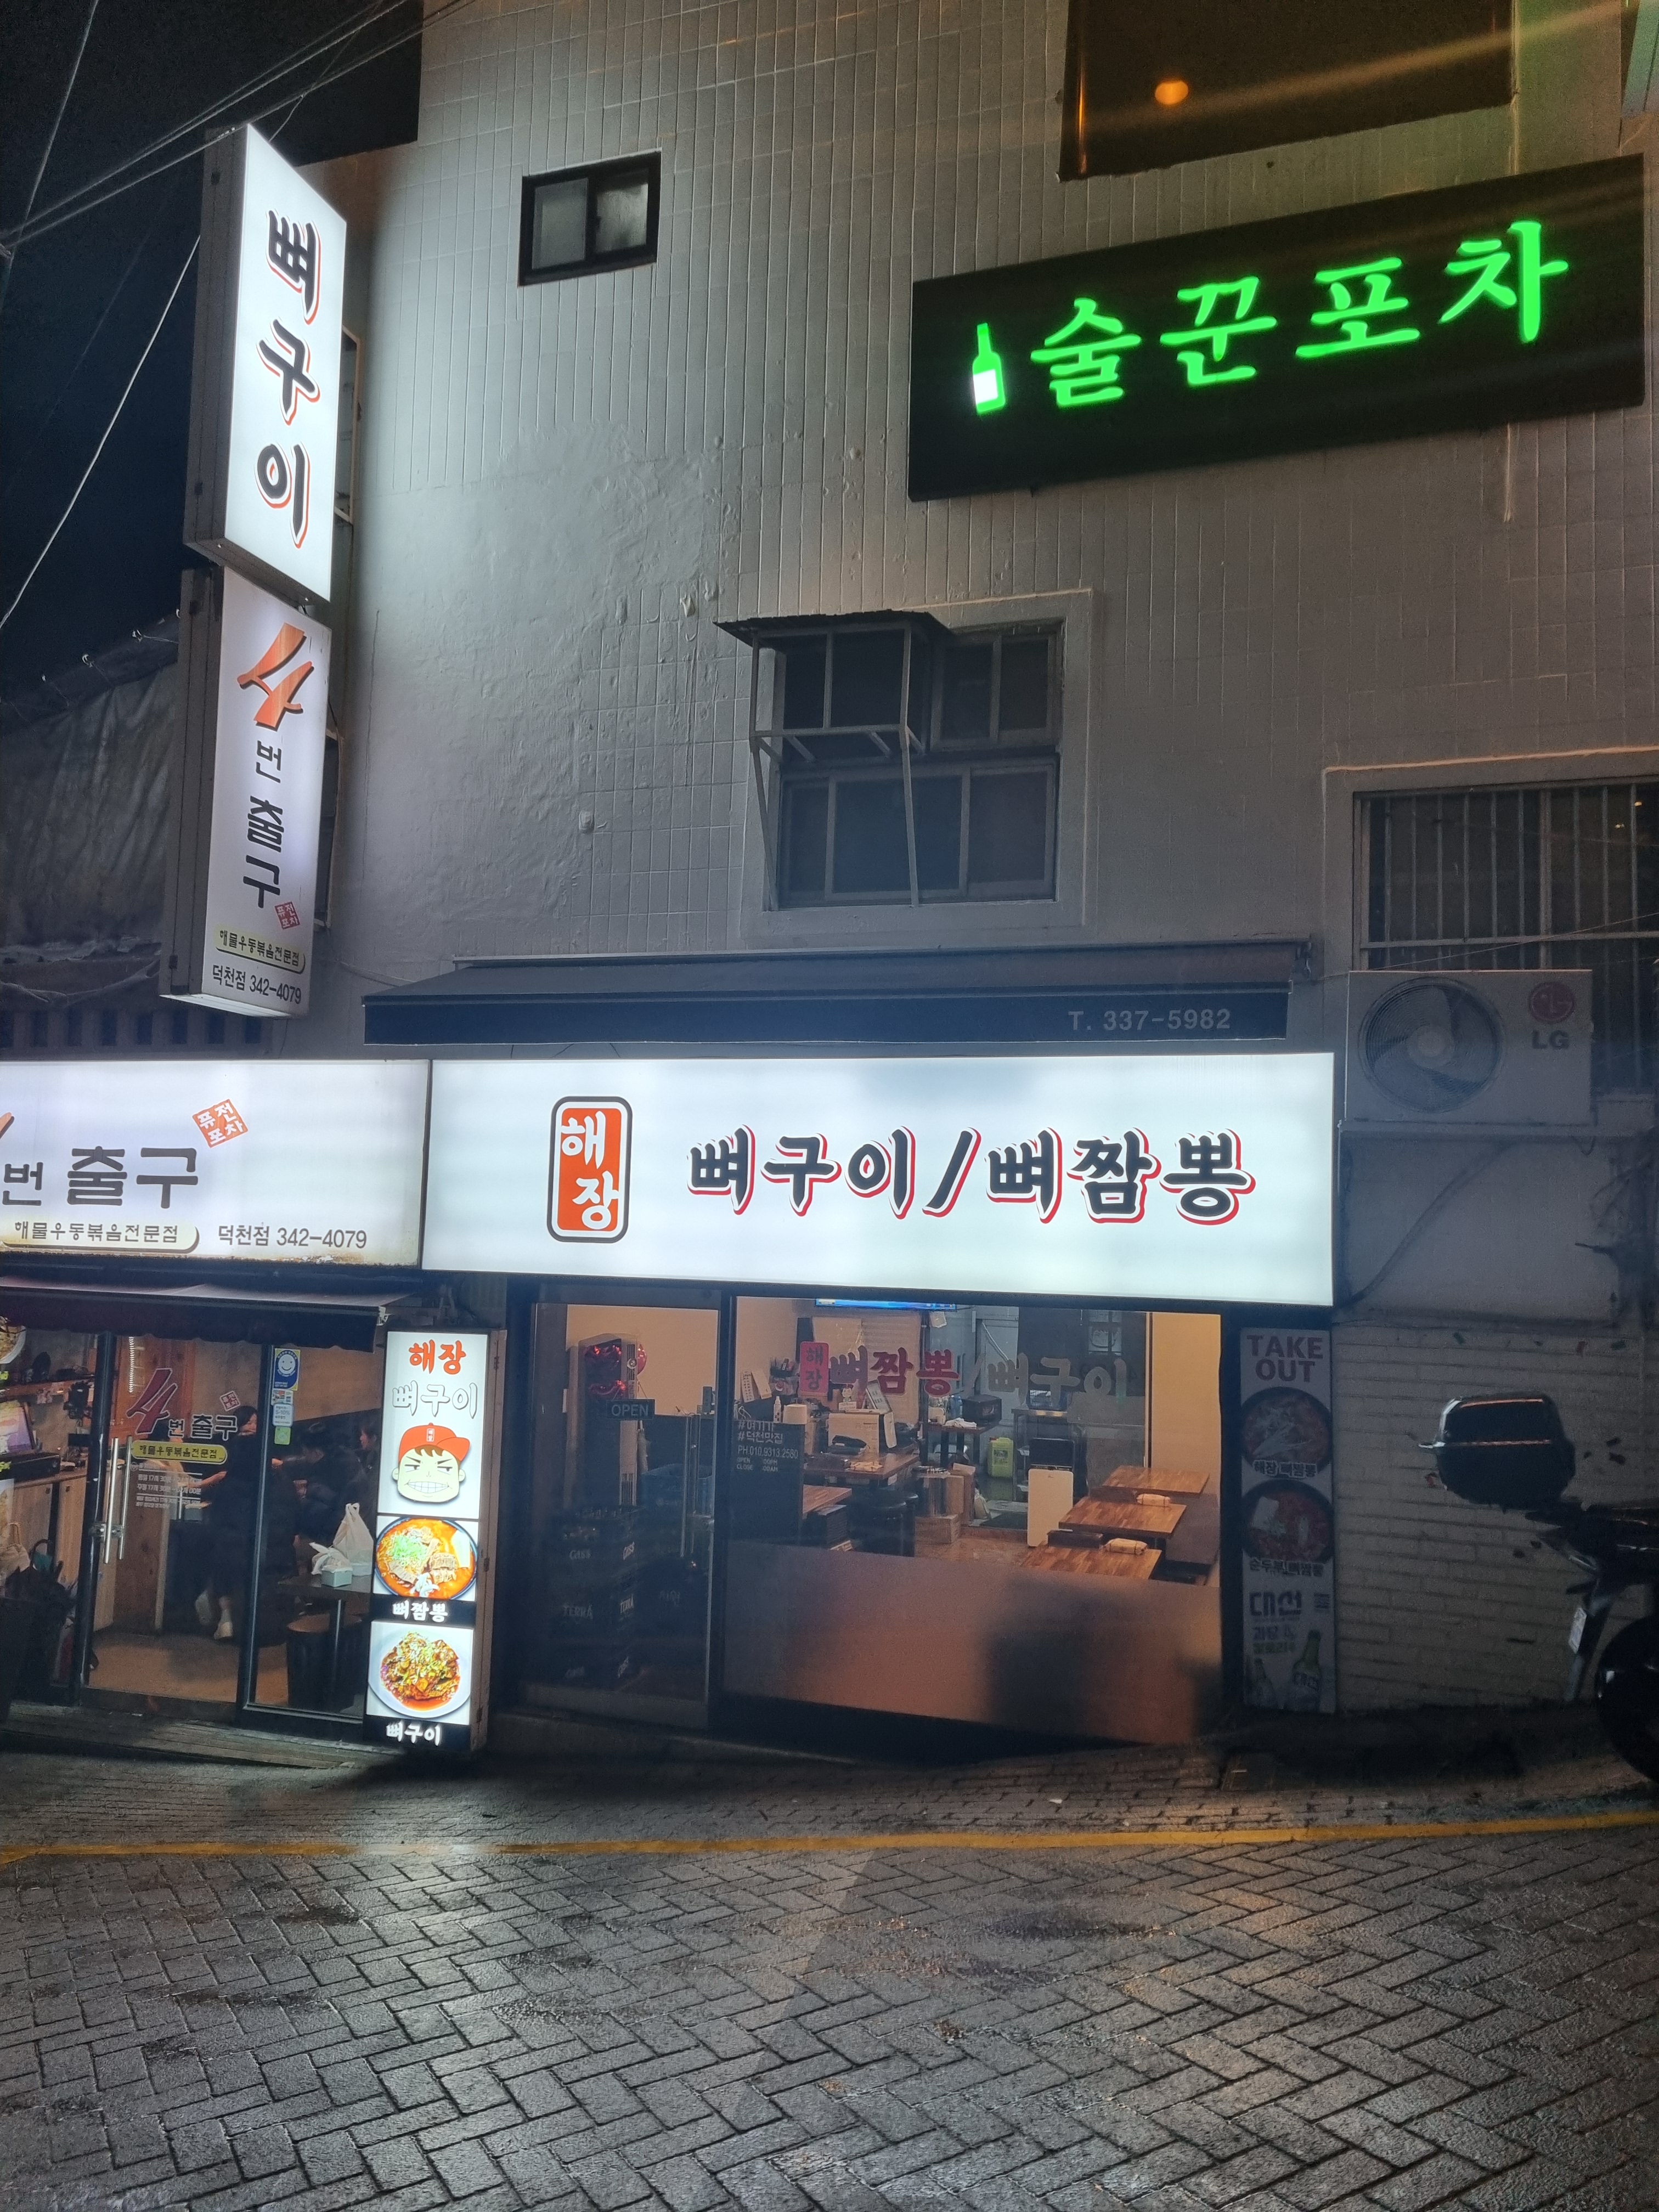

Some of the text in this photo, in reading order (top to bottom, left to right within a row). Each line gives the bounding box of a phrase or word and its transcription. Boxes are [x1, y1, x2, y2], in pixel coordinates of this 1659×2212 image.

[1030, 221, 1568, 407] 술꾼포차
[255, 208, 320, 549] 뼈구이
[276, 904, 295, 917] 퓨전
[282, 916, 298, 927] 포차
[212, 964, 301, 1005] 덕천점 342-4079
[1103, 1008, 1231, 1031] 337-5982
[1532, 1030, 1570, 1049] LG
[197, 1102, 237, 1129] 퓨전
[207, 1120, 243, 1145] 포차
[560, 1110, 619, 1230] 해장
[15, 1221, 178, 1244] 해물우동볶음전문점
[218, 1224, 368, 1249] 덕천점 342-4079
[408, 1339, 467, 1375] 해장
[1246, 1335, 1324, 1359] TAKE
[806, 1345, 823, 1390] 해장
[1255, 1358, 1315, 1383] OUT
[392, 1380, 478, 1419] 뼈구이
[611, 1404, 648, 1417] OPEN
[738, 1431, 783, 1444] #덕천맛집
[392, 1600, 448, 1622] 뼈짬뽕
[386, 1720, 441, 1746] 뼈구이
